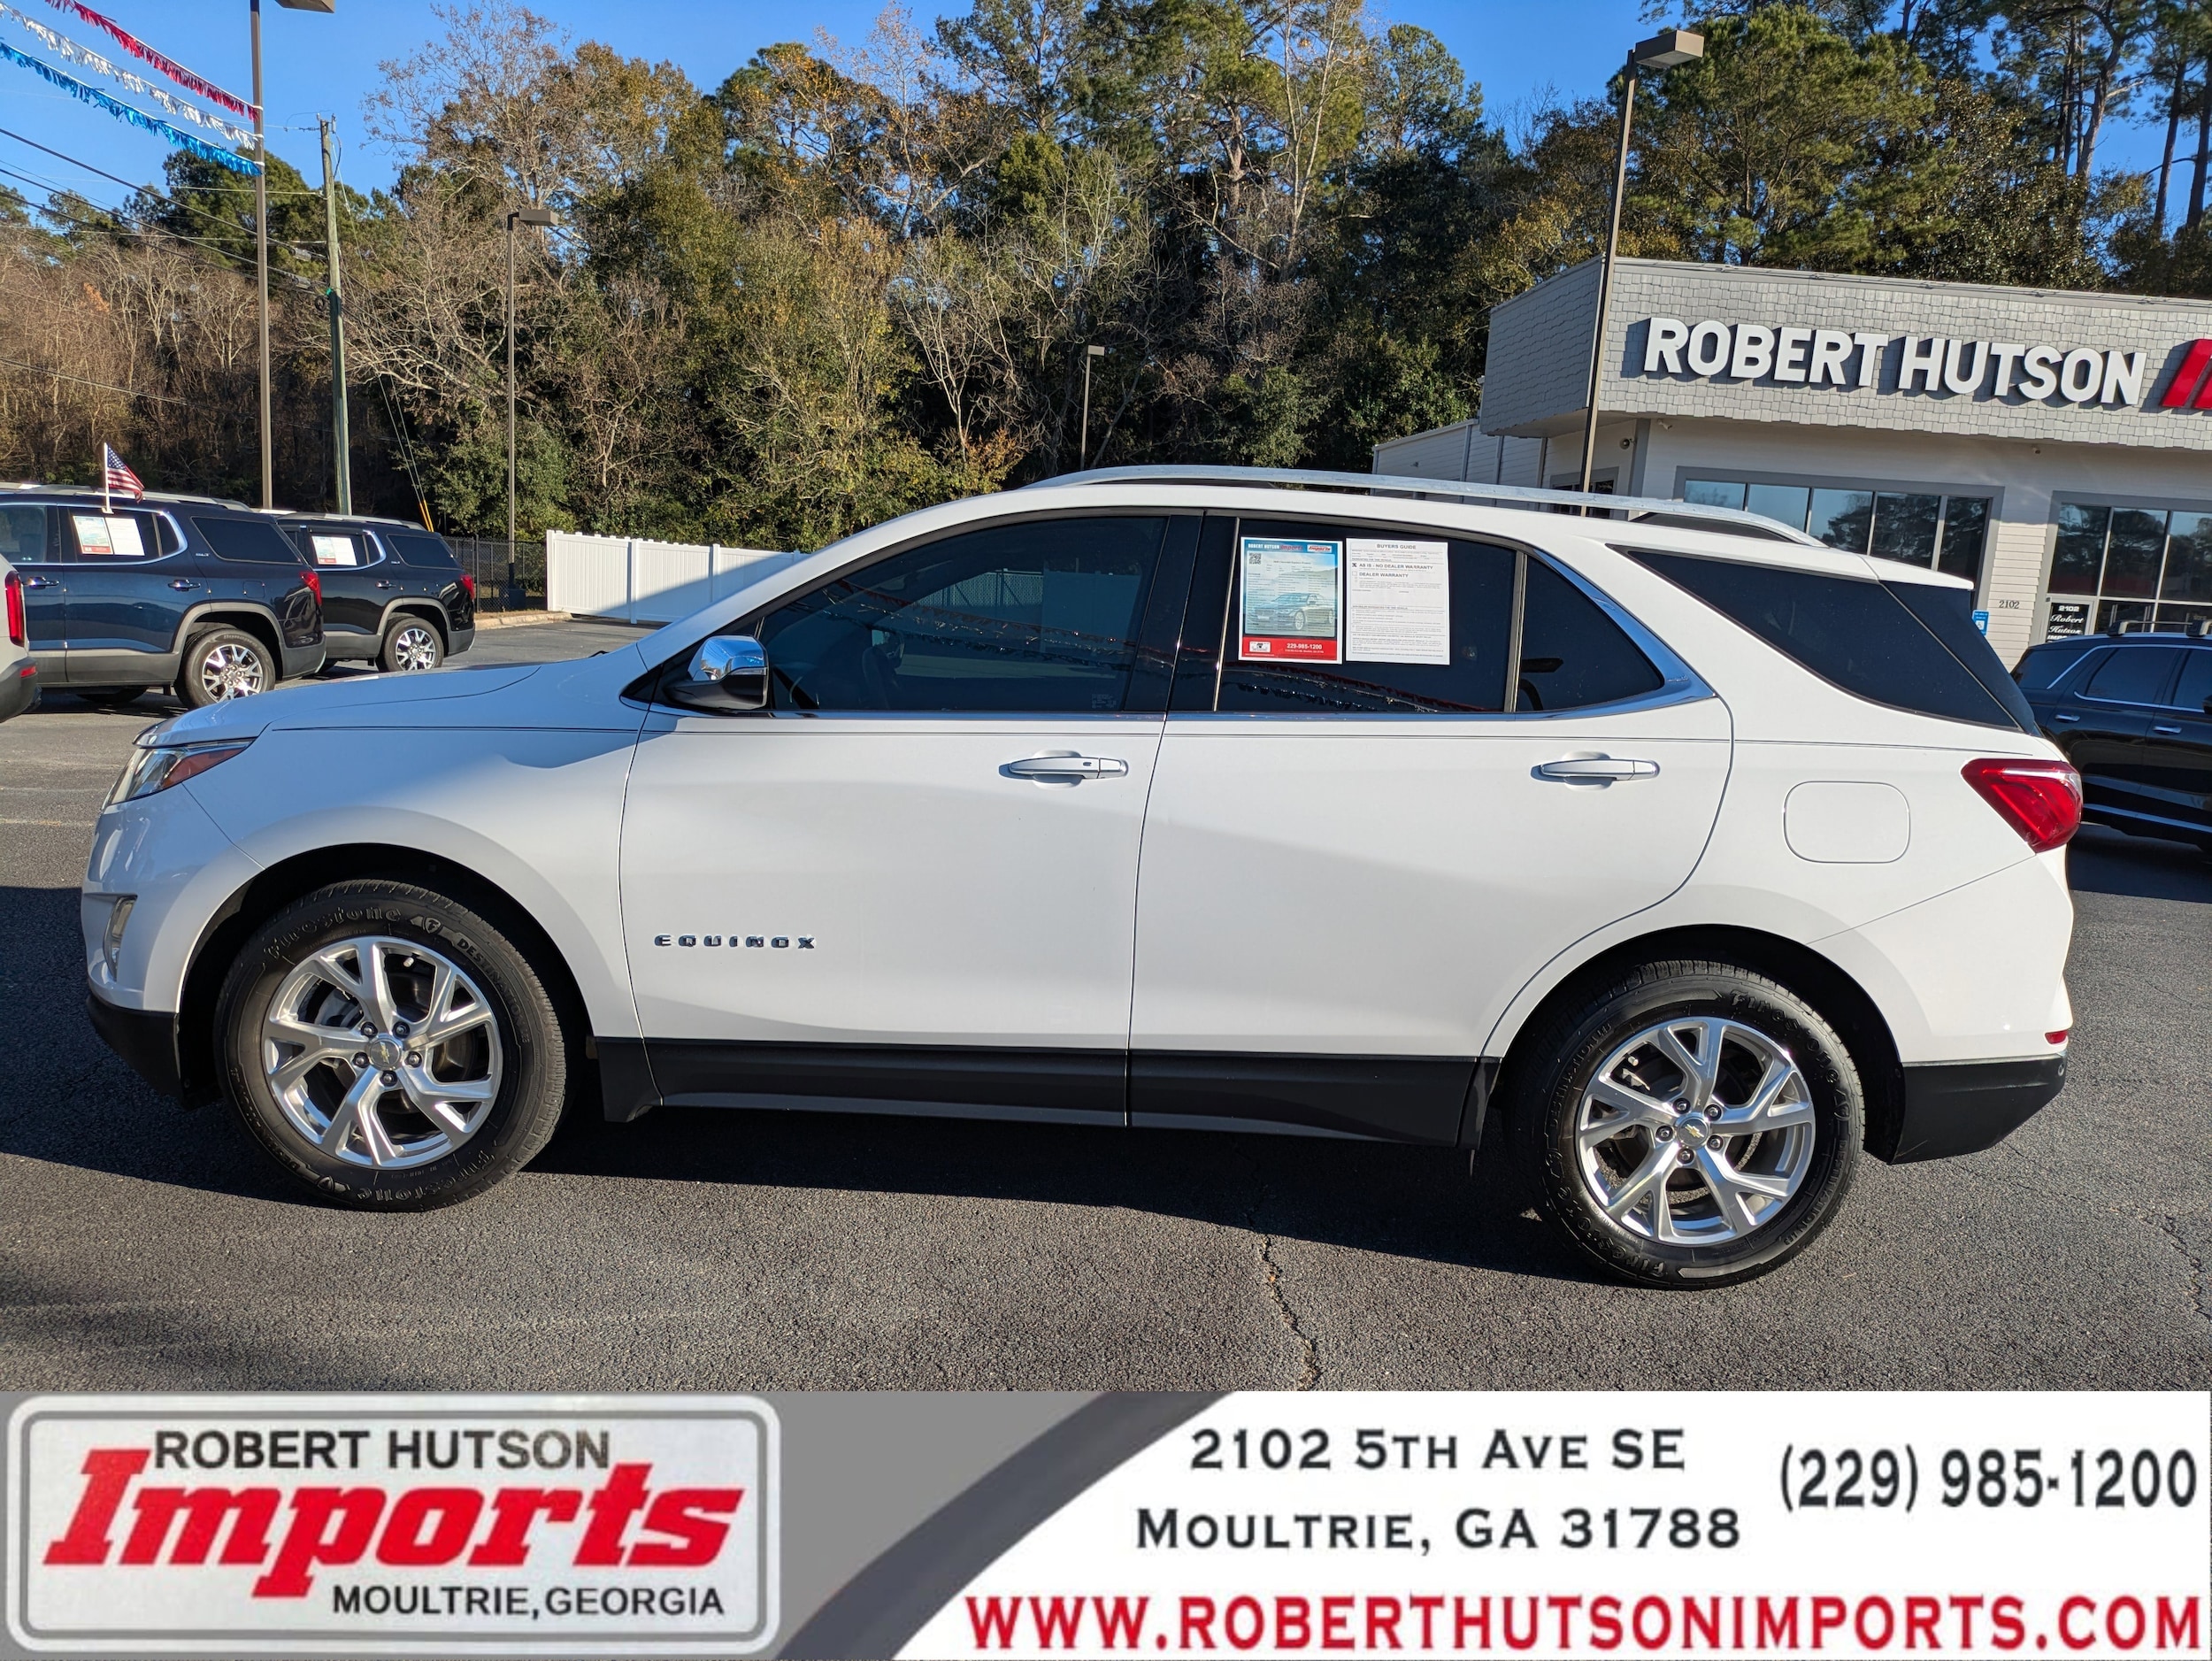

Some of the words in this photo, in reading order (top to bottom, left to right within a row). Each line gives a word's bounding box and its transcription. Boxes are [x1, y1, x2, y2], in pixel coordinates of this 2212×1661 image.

[1644, 317, 1889, 387] ROBERT
[1898, 335, 2147, 405] HUTSON
[1999, 600, 2020, 609] 2102
[2050, 614, 2085, 623] Robert
[654, 934, 815, 950] EQUINOX
[1730, 988, 1839, 1084] Firestone
